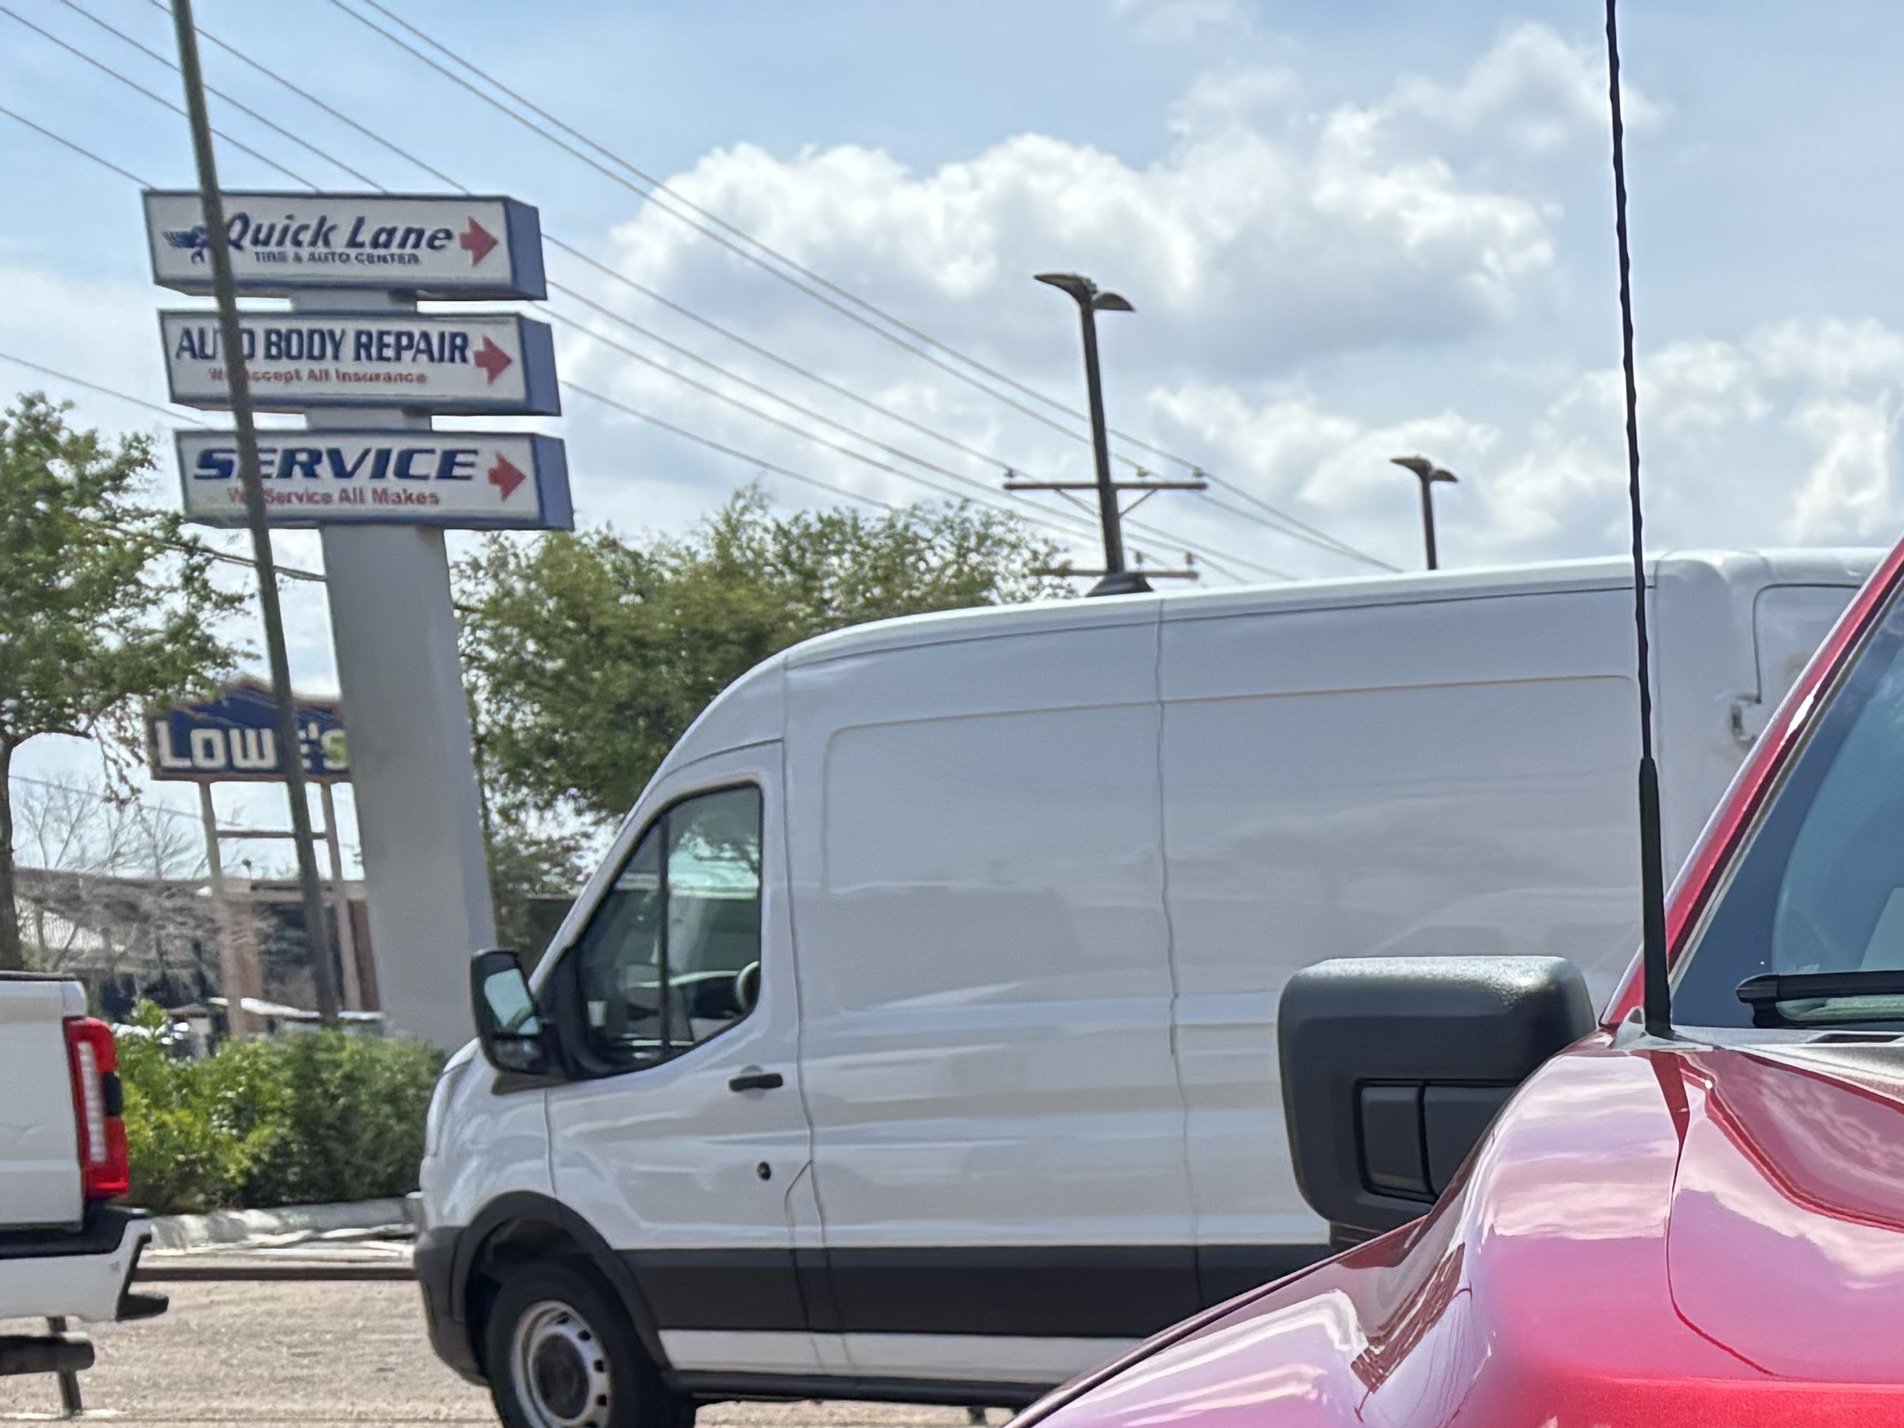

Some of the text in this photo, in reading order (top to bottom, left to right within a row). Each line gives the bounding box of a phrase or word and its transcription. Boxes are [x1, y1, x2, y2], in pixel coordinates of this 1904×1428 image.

[225, 212, 453, 251] Quick Lane
[307, 252, 351, 263] AUTO
[176, 327, 471, 364] AUO BODY REPAIR
[338, 487, 364, 504] All
[371, 487, 440, 505] Makes
